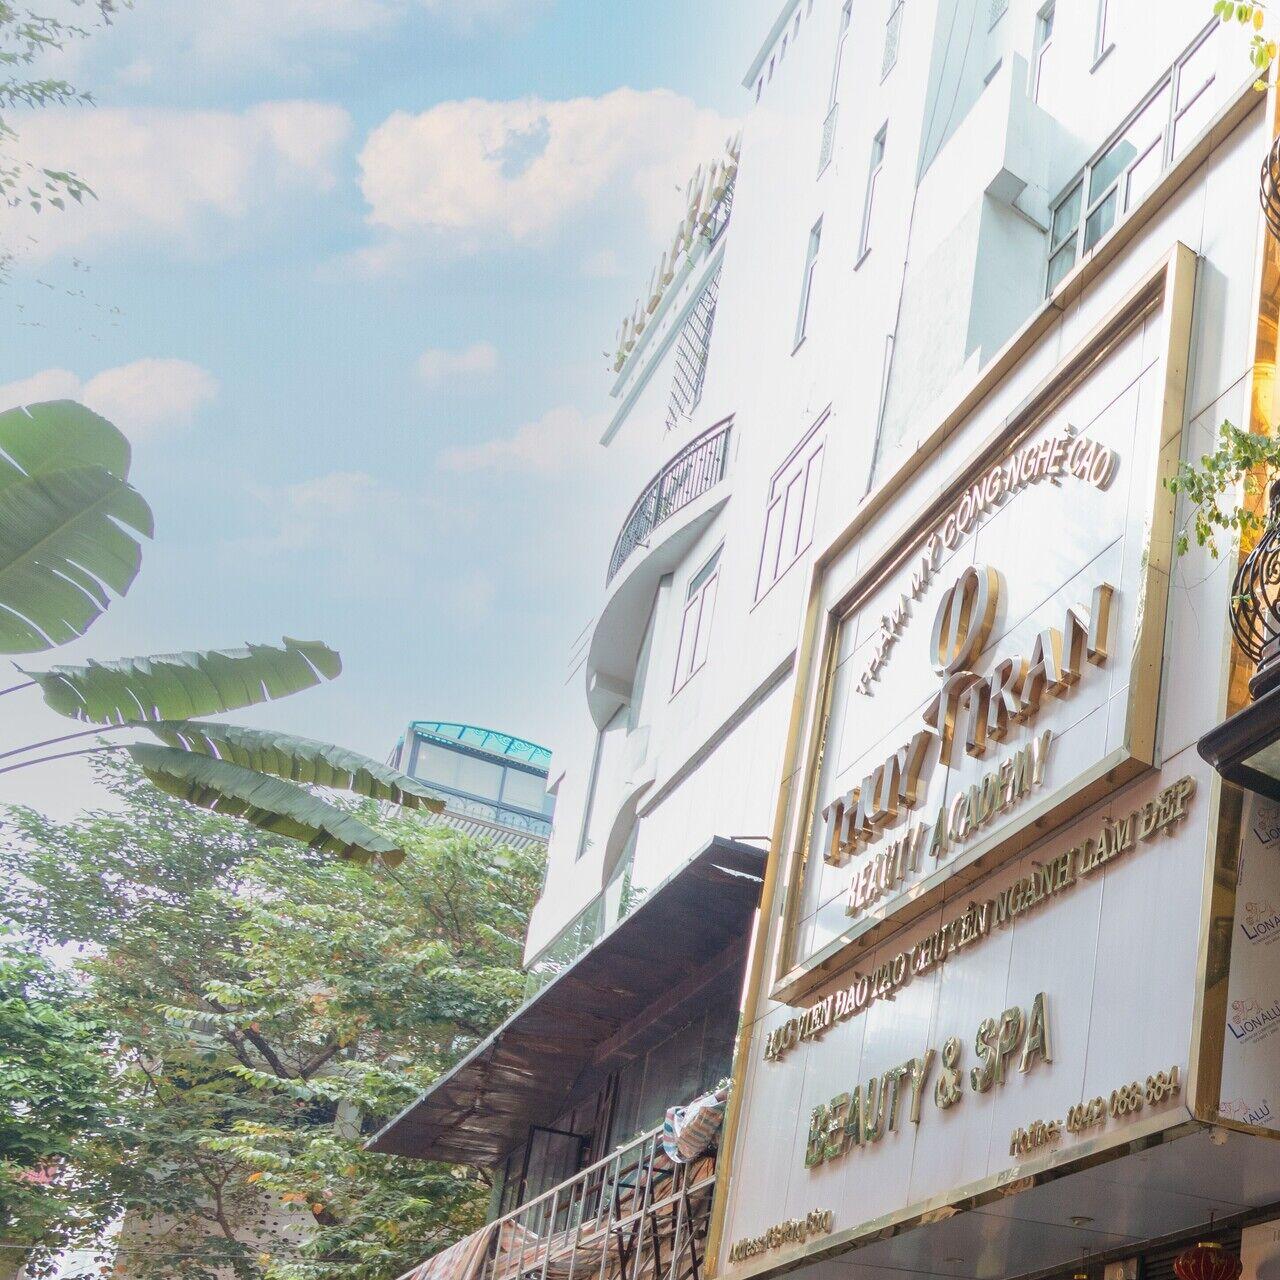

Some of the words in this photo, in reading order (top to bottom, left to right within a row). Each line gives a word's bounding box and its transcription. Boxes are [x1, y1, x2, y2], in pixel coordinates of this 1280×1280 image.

[1066, 434, 1120, 492] CAO
[928, 739, 1053, 858] ACADEMY
[804, 1048, 937, 1169] BEAUTY
[934, 1034, 964, 1110] &
[969, 990, 1054, 1094] SPA
